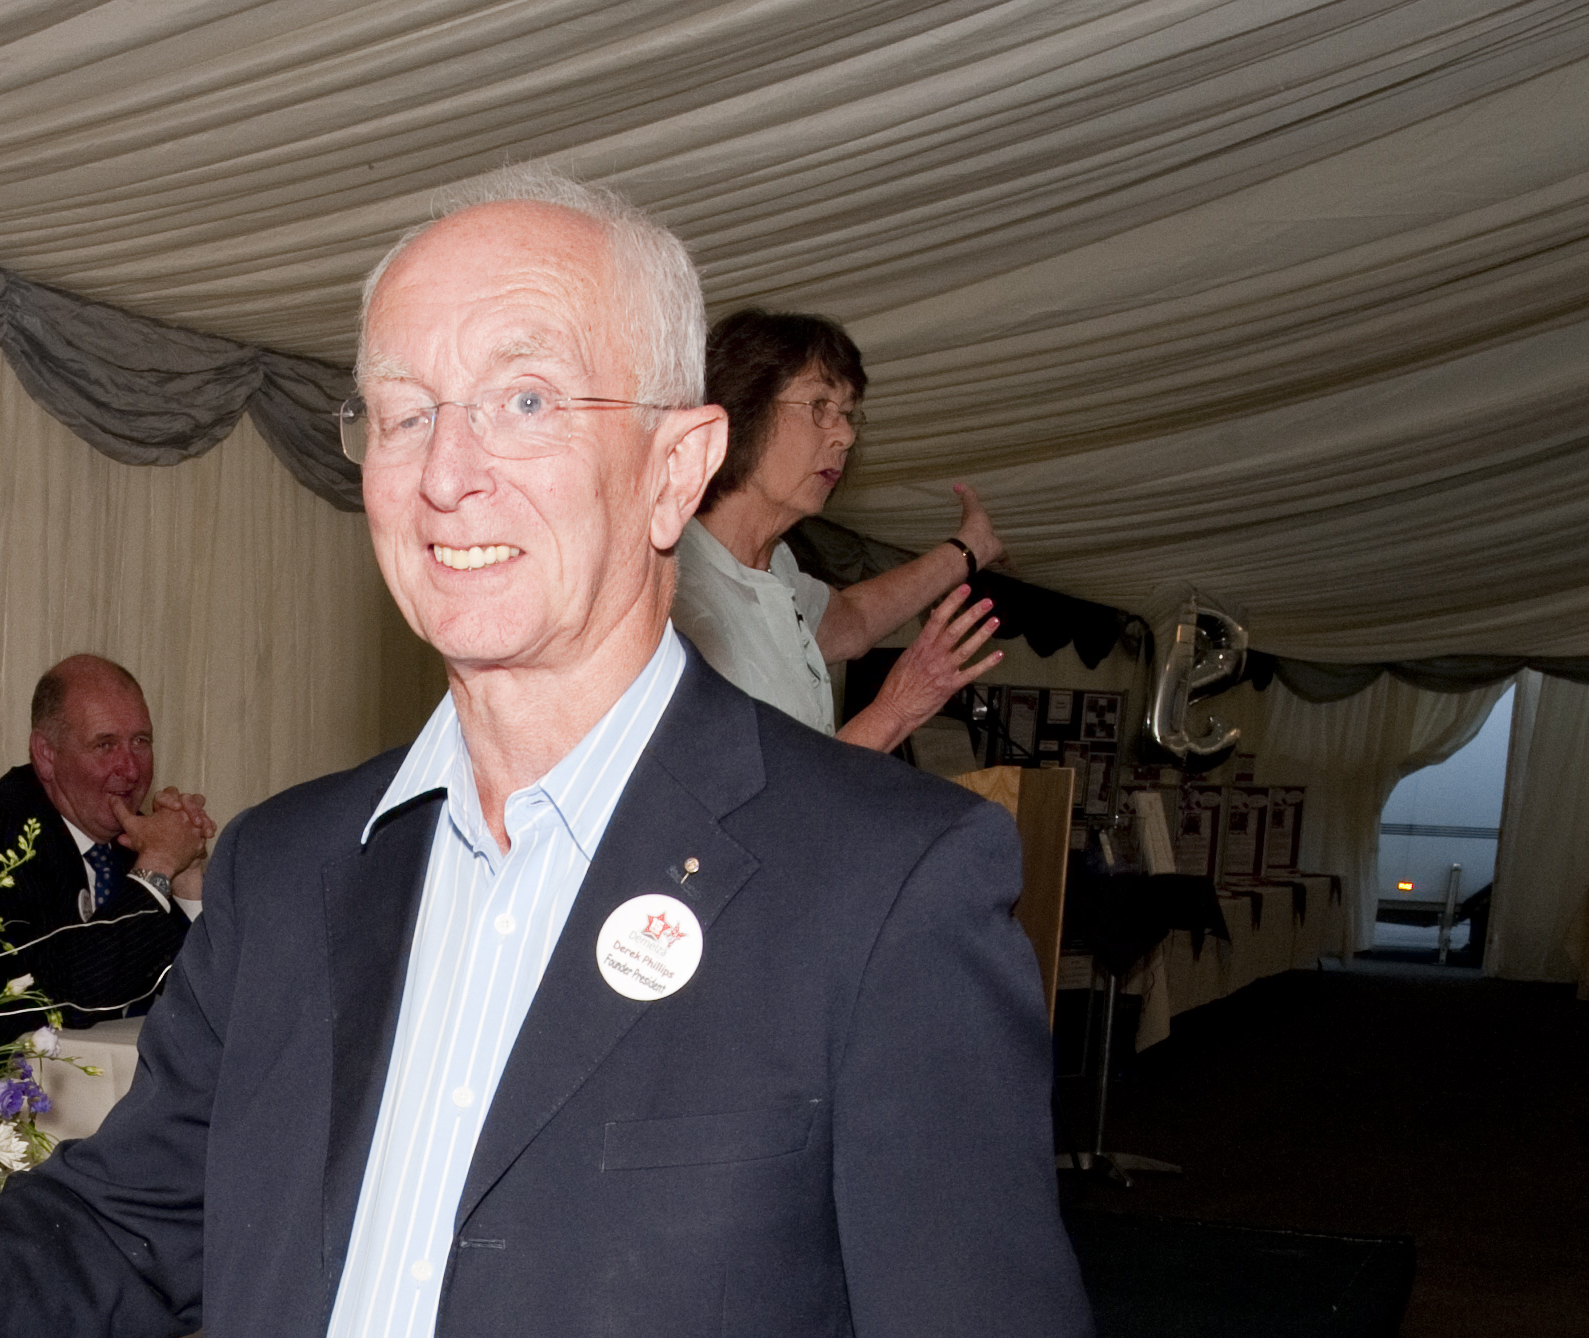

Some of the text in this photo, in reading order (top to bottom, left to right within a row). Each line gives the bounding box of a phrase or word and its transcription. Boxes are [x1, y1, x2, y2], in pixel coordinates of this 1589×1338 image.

[603, 953, 667, 994] Founder President
[613, 940, 676, 979] Derek Phillips
